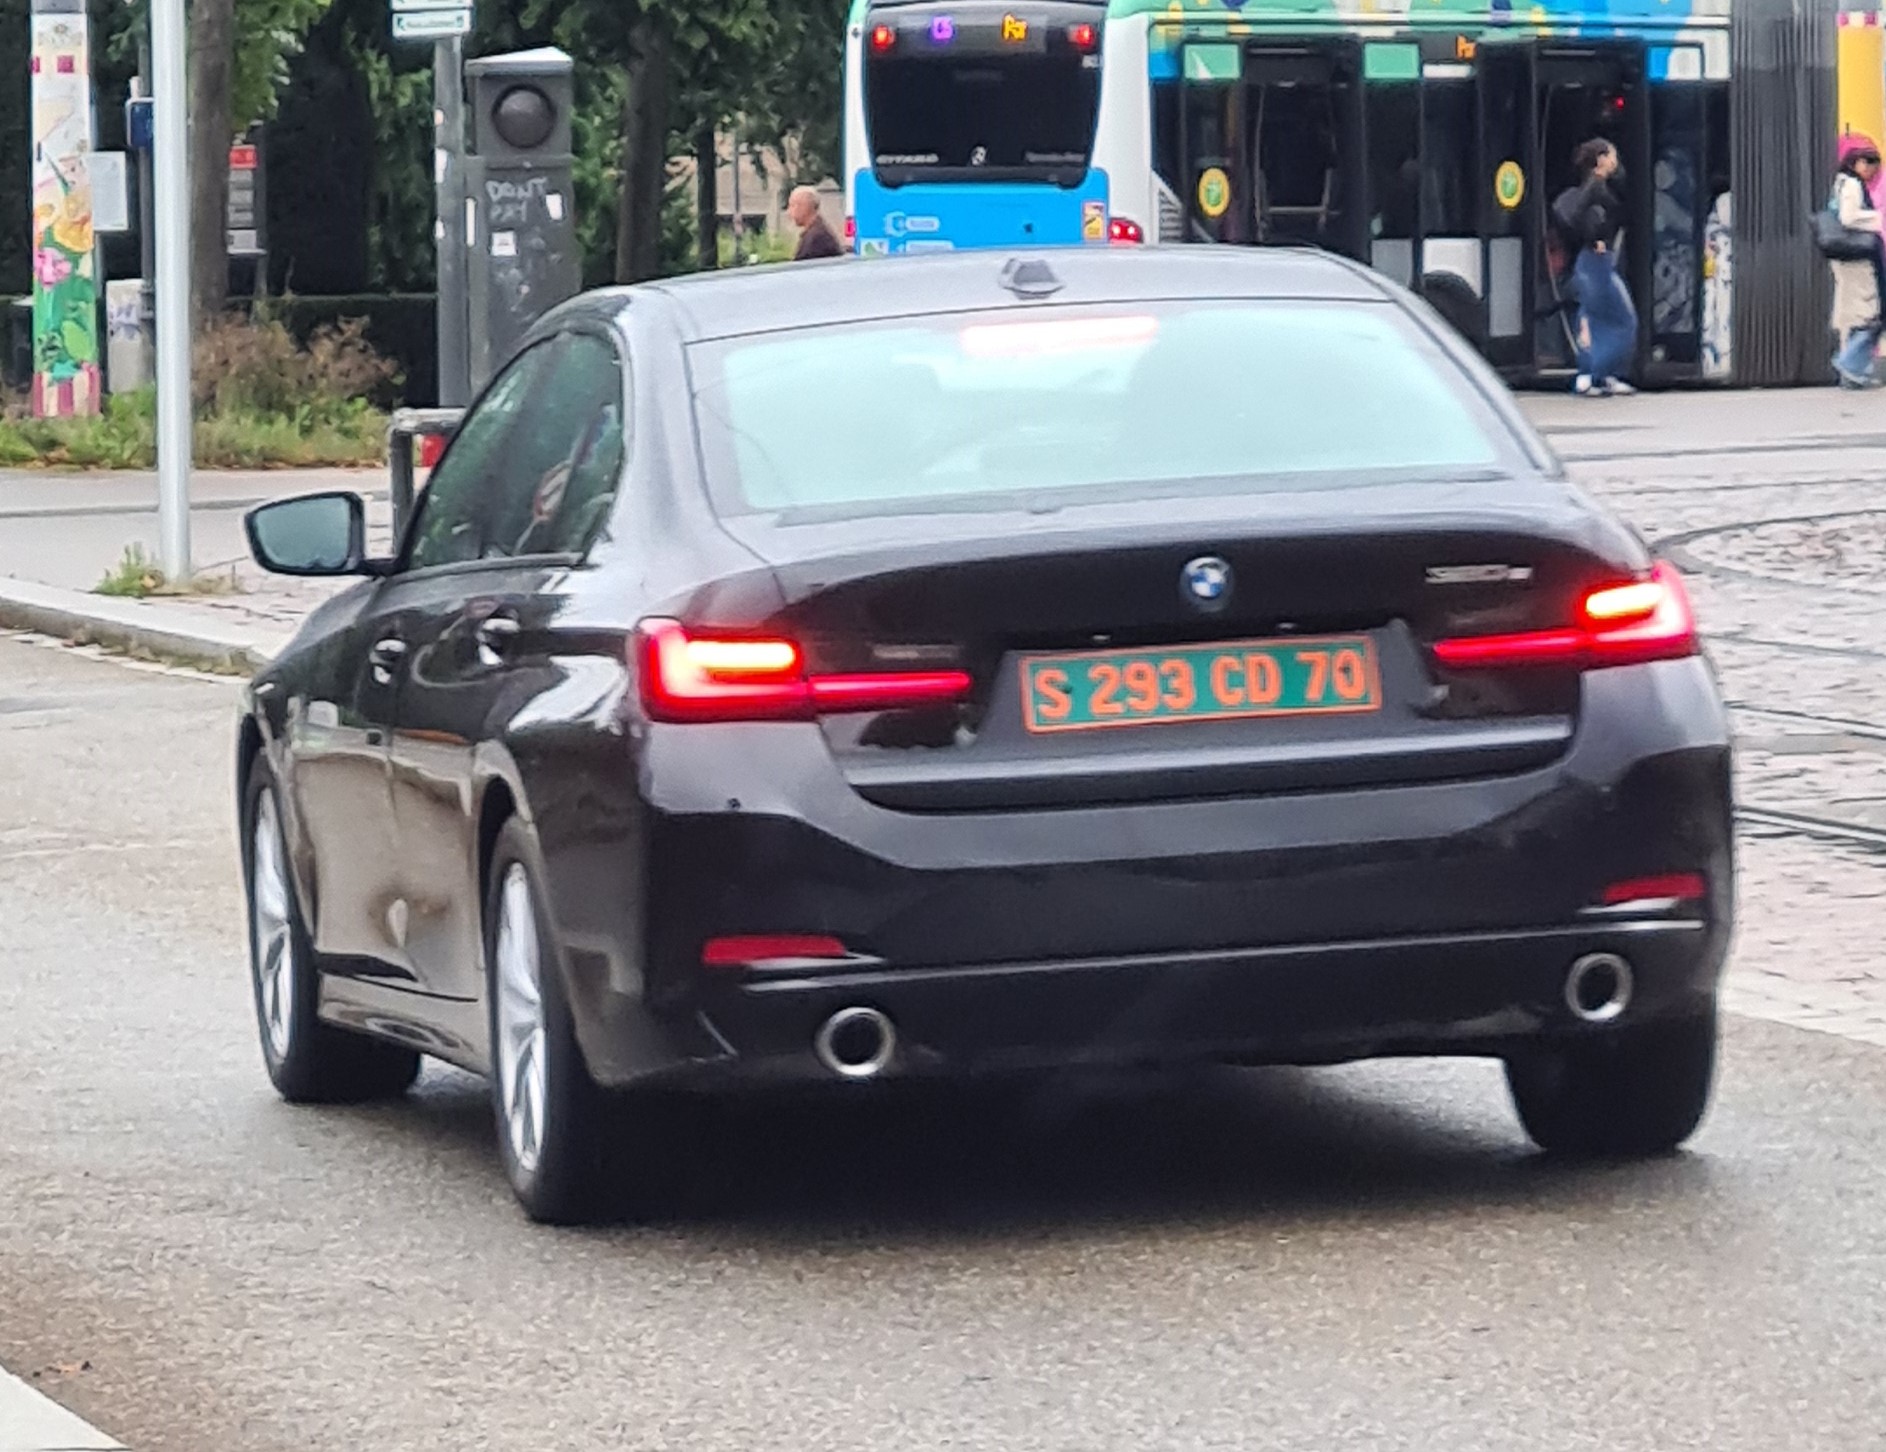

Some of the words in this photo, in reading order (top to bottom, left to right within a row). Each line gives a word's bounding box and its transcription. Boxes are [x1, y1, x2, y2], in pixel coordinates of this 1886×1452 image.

[1033, 668, 1073, 719] S
[1088, 659, 1196, 716] 293
[1211, 652, 1281, 707] CD
[1295, 649, 1367, 702] 70
